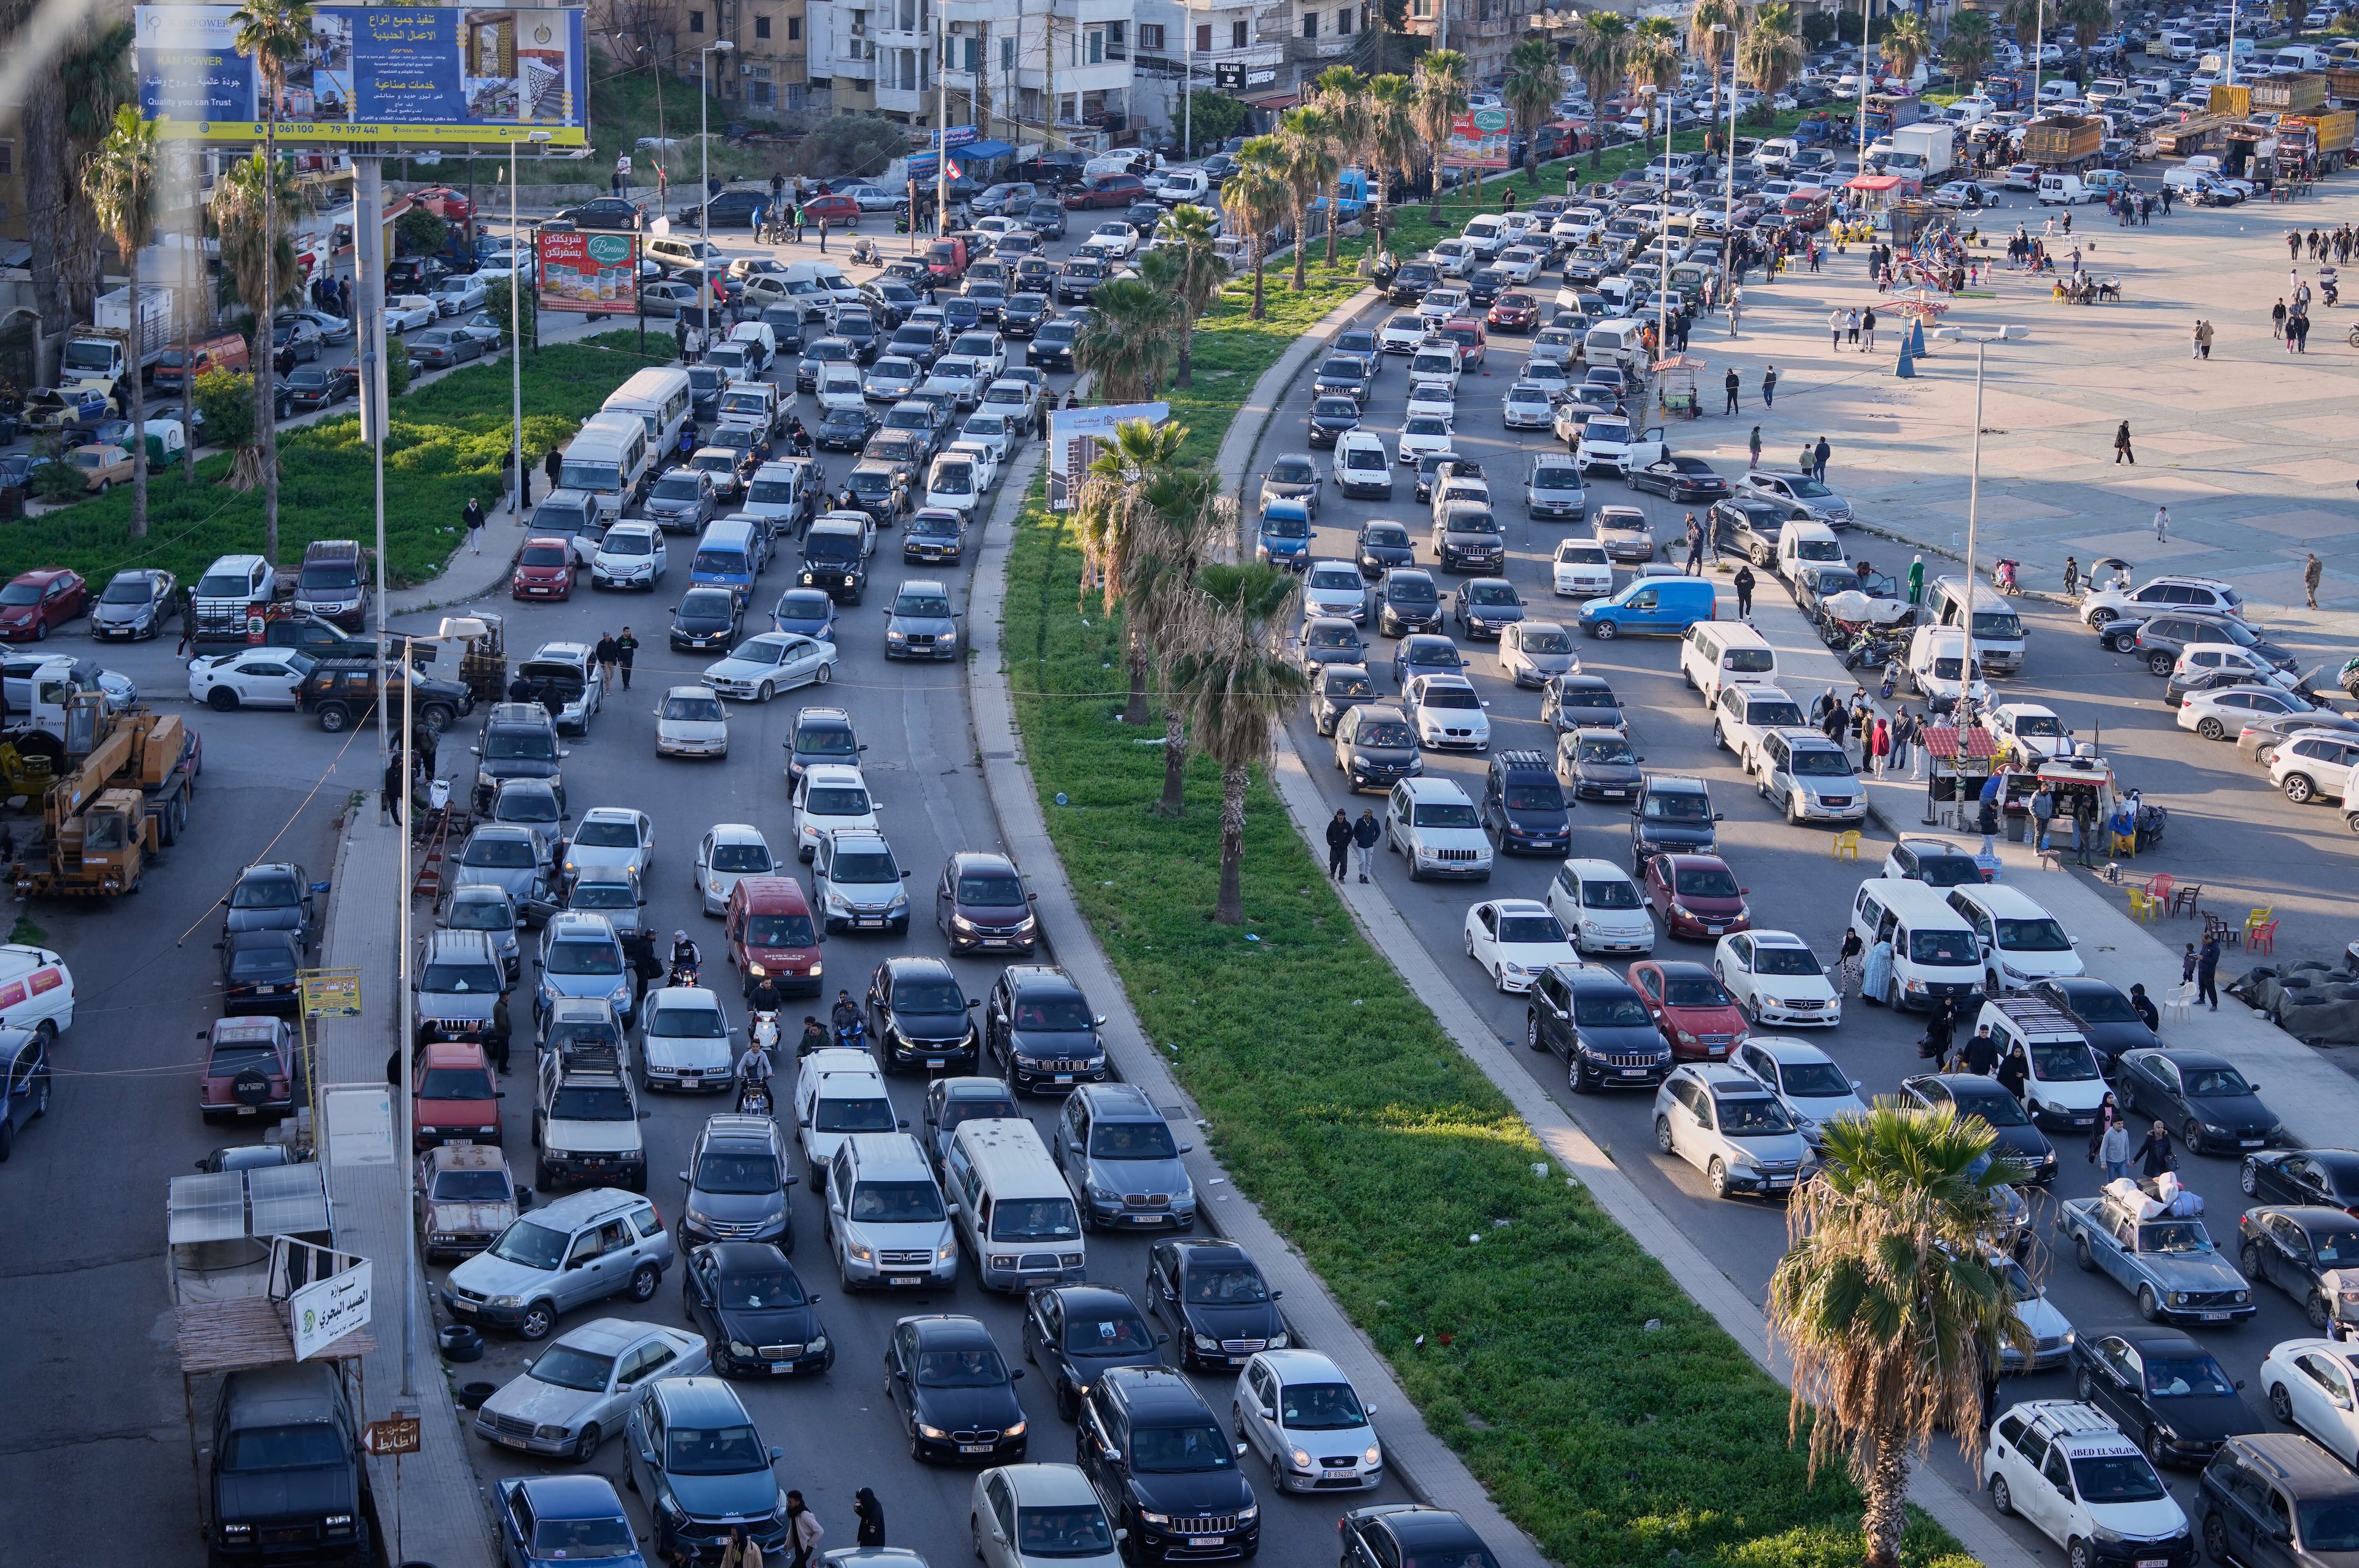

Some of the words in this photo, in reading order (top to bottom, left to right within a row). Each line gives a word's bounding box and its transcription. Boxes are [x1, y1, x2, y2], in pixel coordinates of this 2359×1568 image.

[369, 14, 390, 27] انواع
[393, 16, 413, 28] جميع
[417, 13, 435, 26] تنفيذ
[372, 28, 405, 42] الحديدية
[407, 30, 436, 42] الاعمال
[157, 56, 181, 65] KAM
[184, 57, 222, 66] POWER
[146, 76, 166, 87] وطنية
[169, 79, 187, 88] بروح
[222, 77, 240, 87] جودة
[375, 77, 406, 91] صناعية
[1247, 71, 1269, 85] COFFEE
[408, 80, 435, 90] خدمات
[147, 98, 175, 107] Quality
[278, 125, 294, 133] 061
[297, 125, 314, 133] 100
[593, 240, 626, 254] Benina
[346, 1287, 369, 1313] الصيد
[319, 1300, 345, 1330] البحري
[2071, 1448, 2095, 1457] ABED
